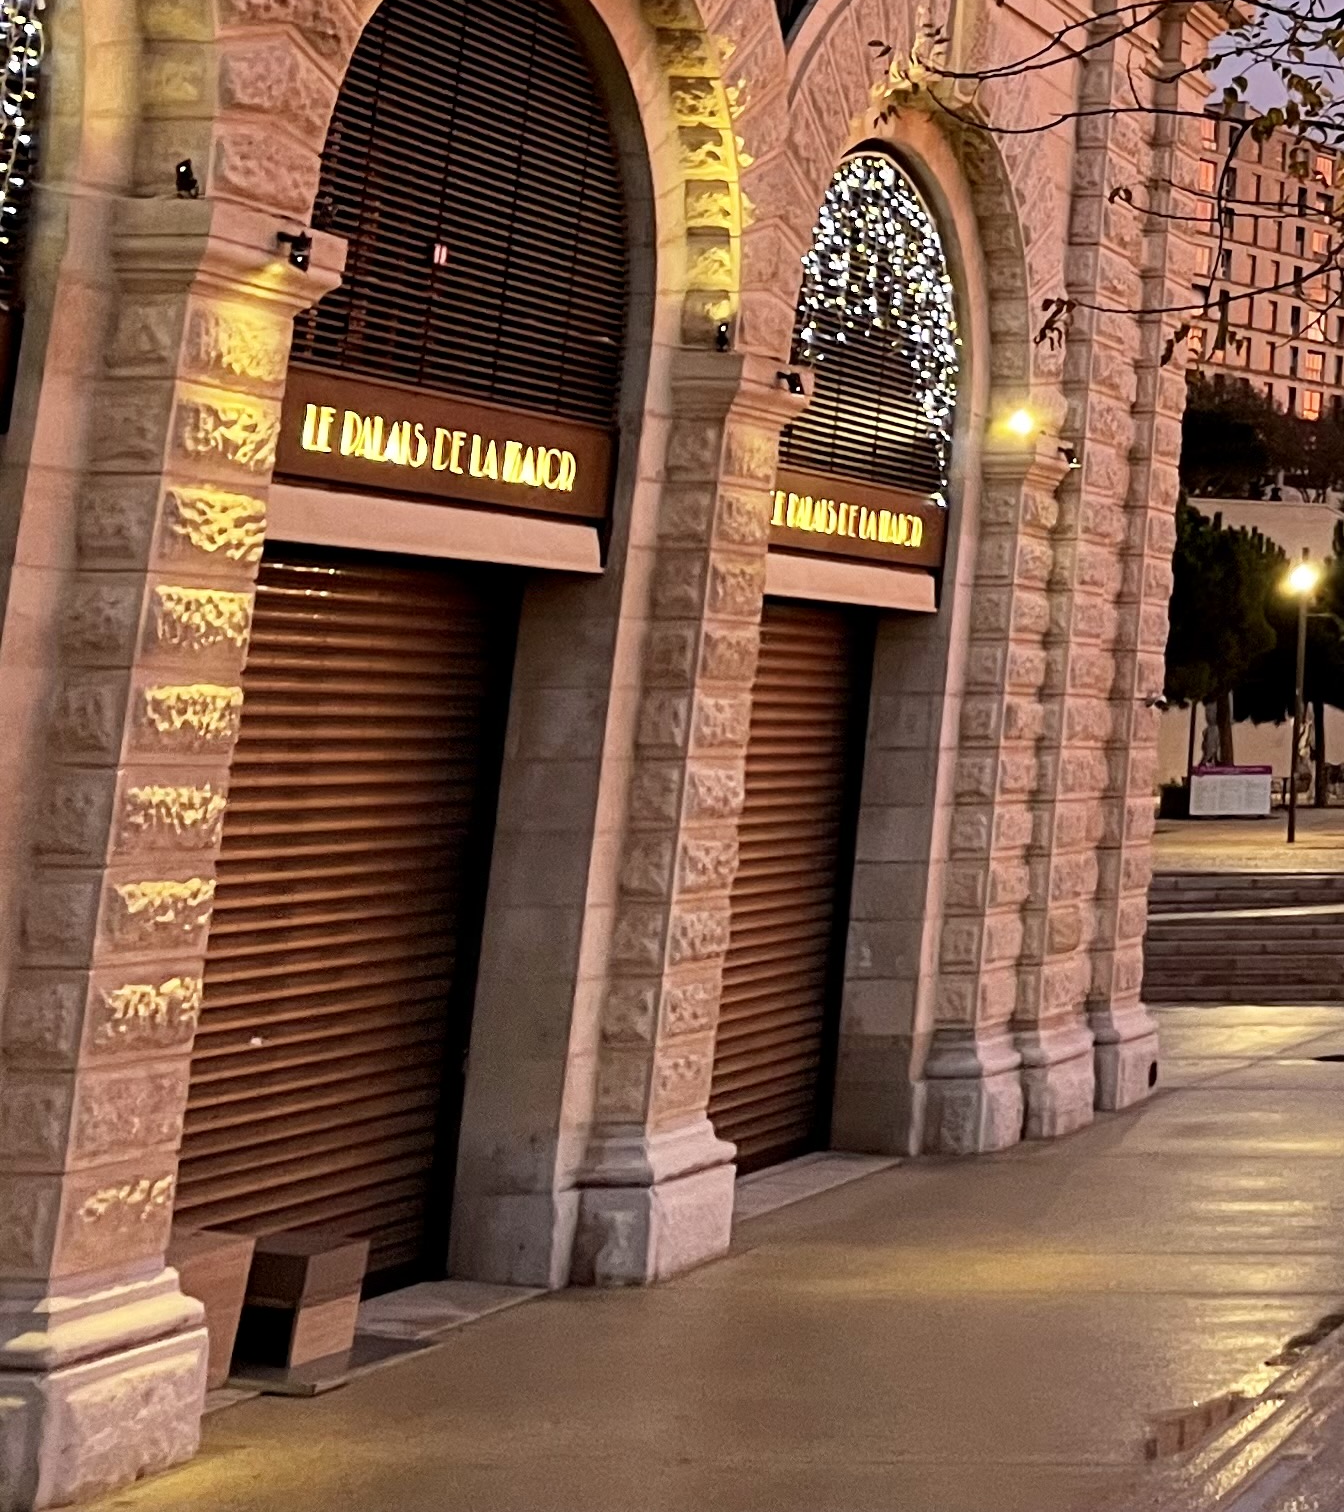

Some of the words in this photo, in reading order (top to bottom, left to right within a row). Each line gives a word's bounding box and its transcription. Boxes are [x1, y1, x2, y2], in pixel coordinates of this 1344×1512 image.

[302, 403, 337, 453] LE
[340, 410, 428, 468] PALAIS
[431, 427, 467, 475] DE
[469, 434, 499, 480] LA
[502, 440, 577, 492] MAJOR
[786, 492, 838, 535] PALAIS
[837, 502, 859, 538] DE
[858, 506, 878, 541] LA
